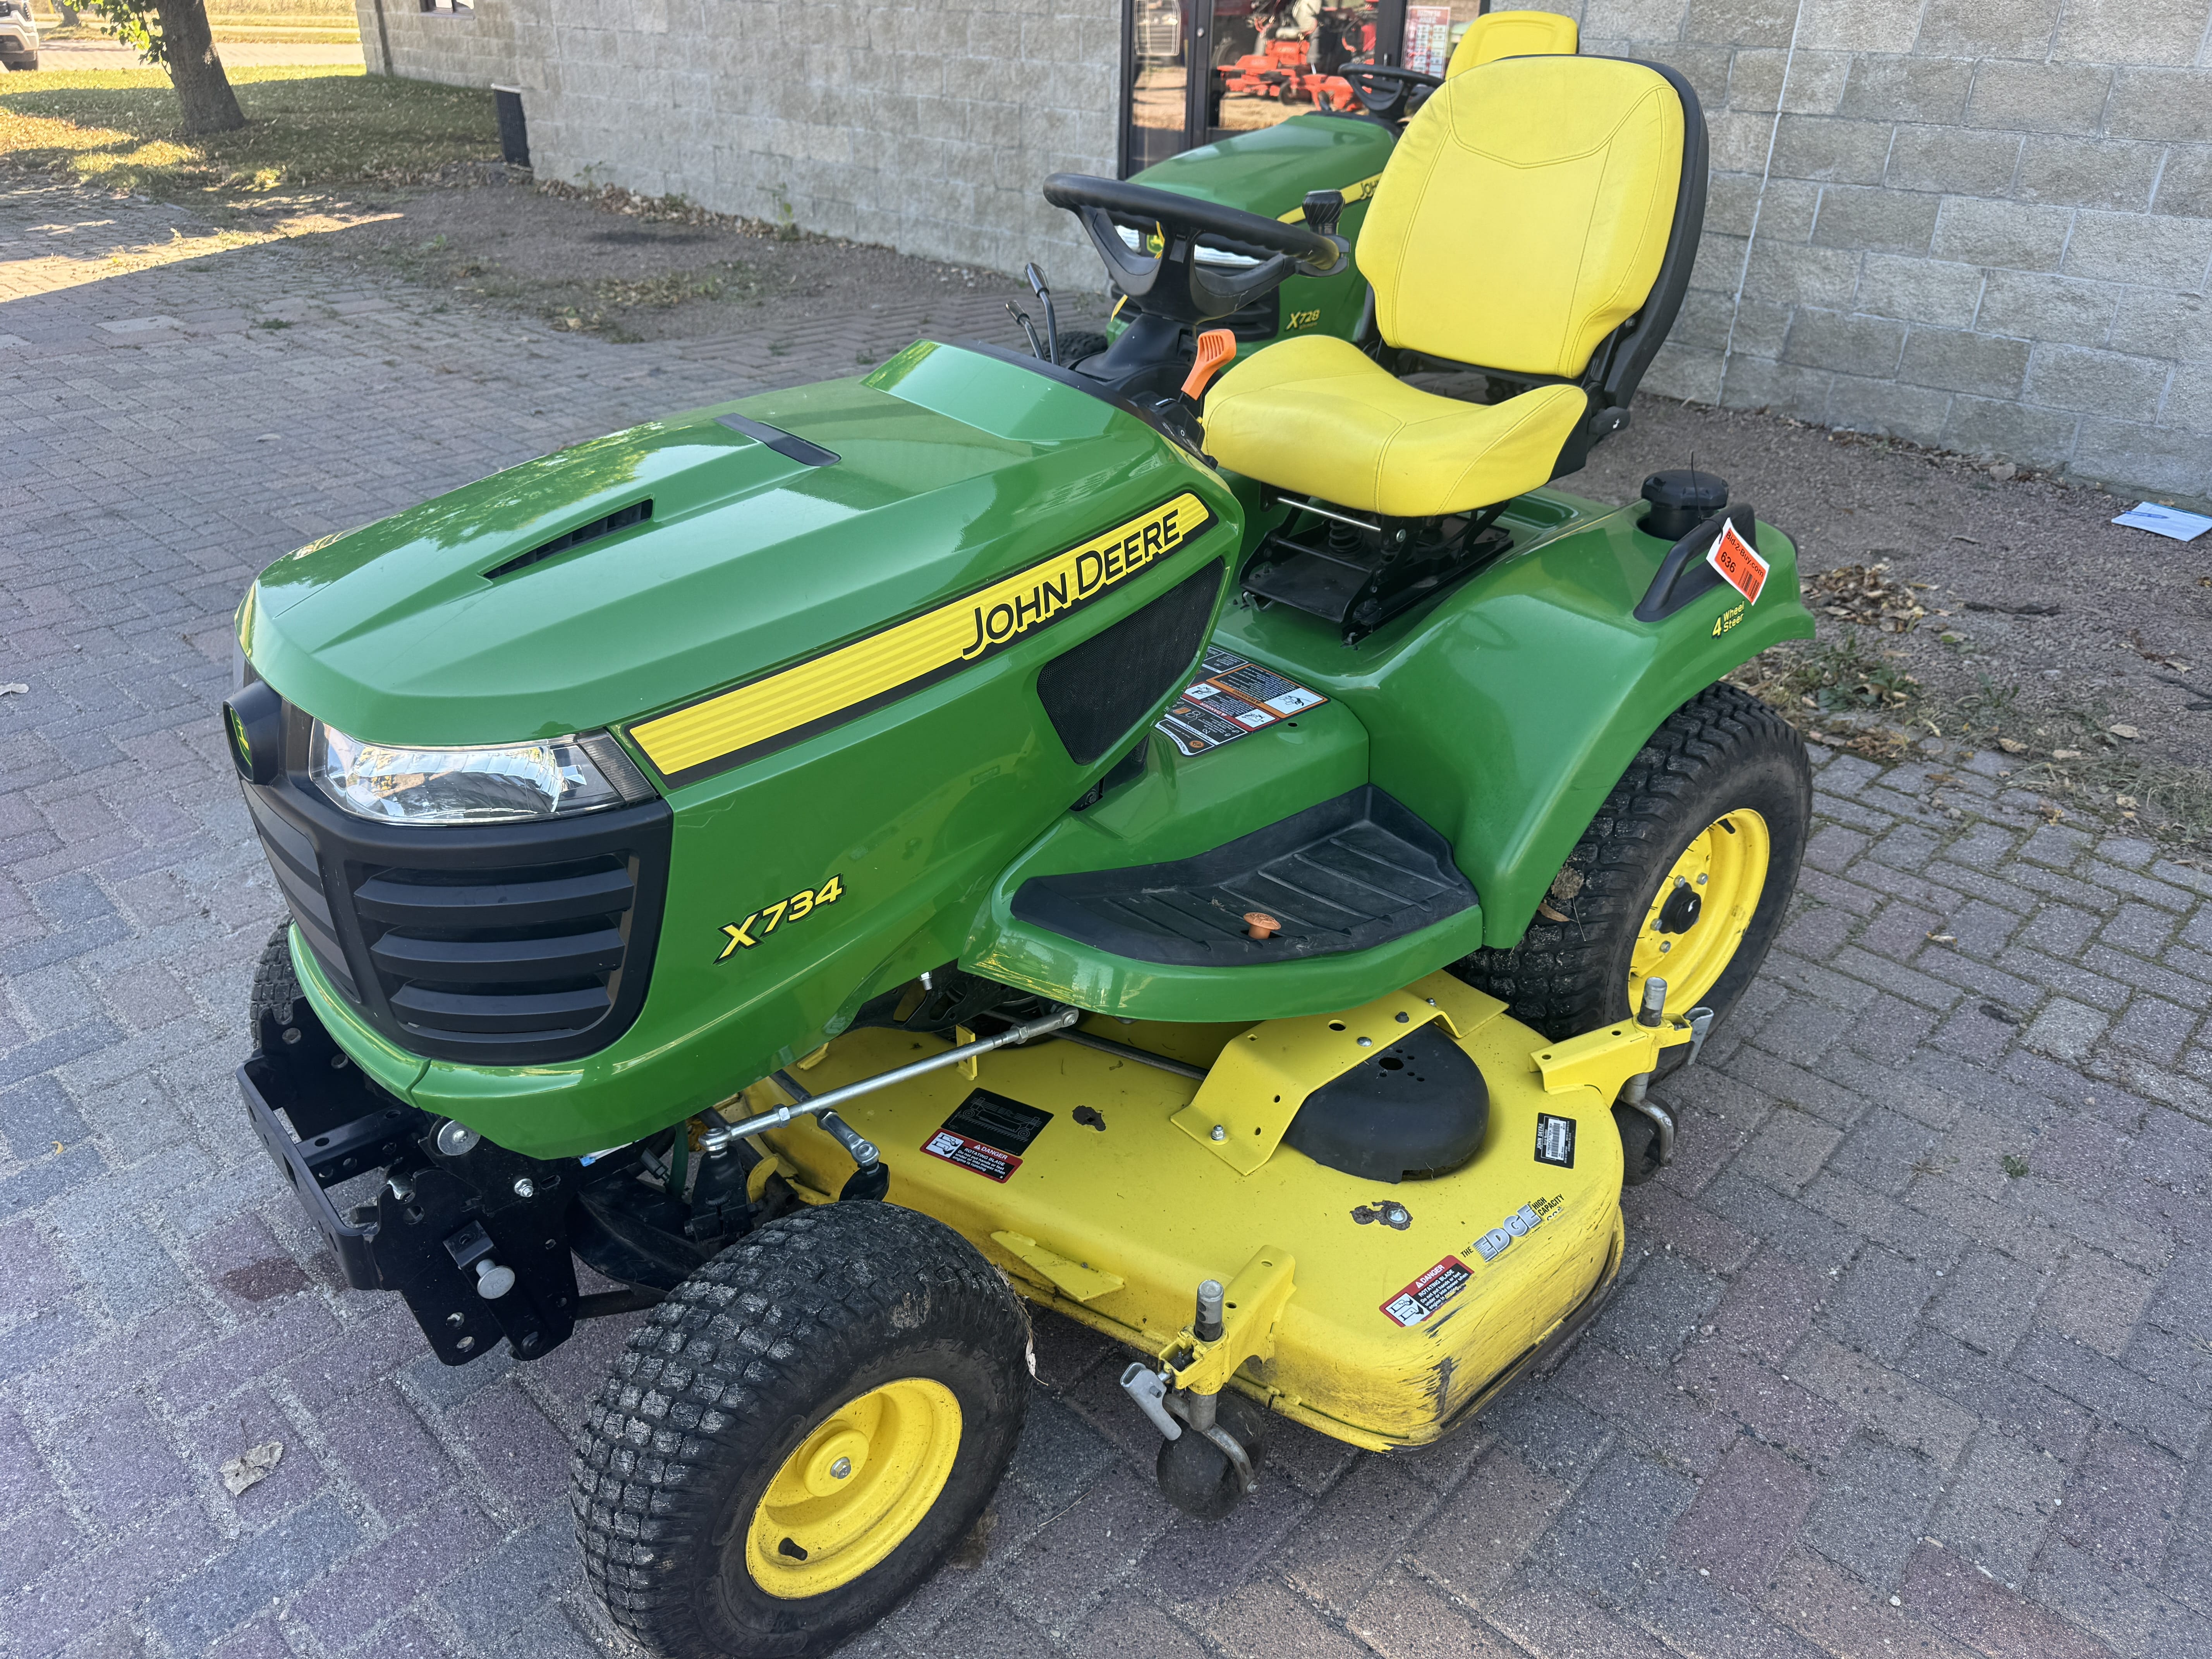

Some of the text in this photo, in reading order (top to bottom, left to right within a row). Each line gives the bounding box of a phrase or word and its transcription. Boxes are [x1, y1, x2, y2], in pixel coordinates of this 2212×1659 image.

[1360, 180, 1379, 200] JOH
[1285, 309, 1320, 330] X728
[1721, 551, 1736, 574] 636
[1726, 531, 1764, 577] Bid-2-Buy.com
[962, 508, 1180, 657] JOHN DEERE
[1712, 601, 1745, 636] 4 Wheel
[1723, 613, 1744, 633] Steer
[716, 874, 844, 962] X734
[964, 1148, 1005, 1166] ROTATING BLADE
[981, 1147, 1007, 1159] DANGER
[971, 1163, 986, 1171] running
[1532, 1197, 1547, 1210] HIGH
[1537, 1194, 1565, 1216] CAPACITY
[1460, 1246, 1474, 1258] THE
[1472, 1204, 1543, 1263] EDGE
[1419, 1269, 1454, 1297] ROTATING BLADE
[1420, 1265, 1444, 1283] DANGER
[1425, 1297, 1436, 1306] under
[1446, 1280, 1458, 1290] mower
[1437, 1280, 1450, 1290] hands
[1429, 1299, 1441, 1309] engine
[856, 1337, 965, 1377] MULTI
